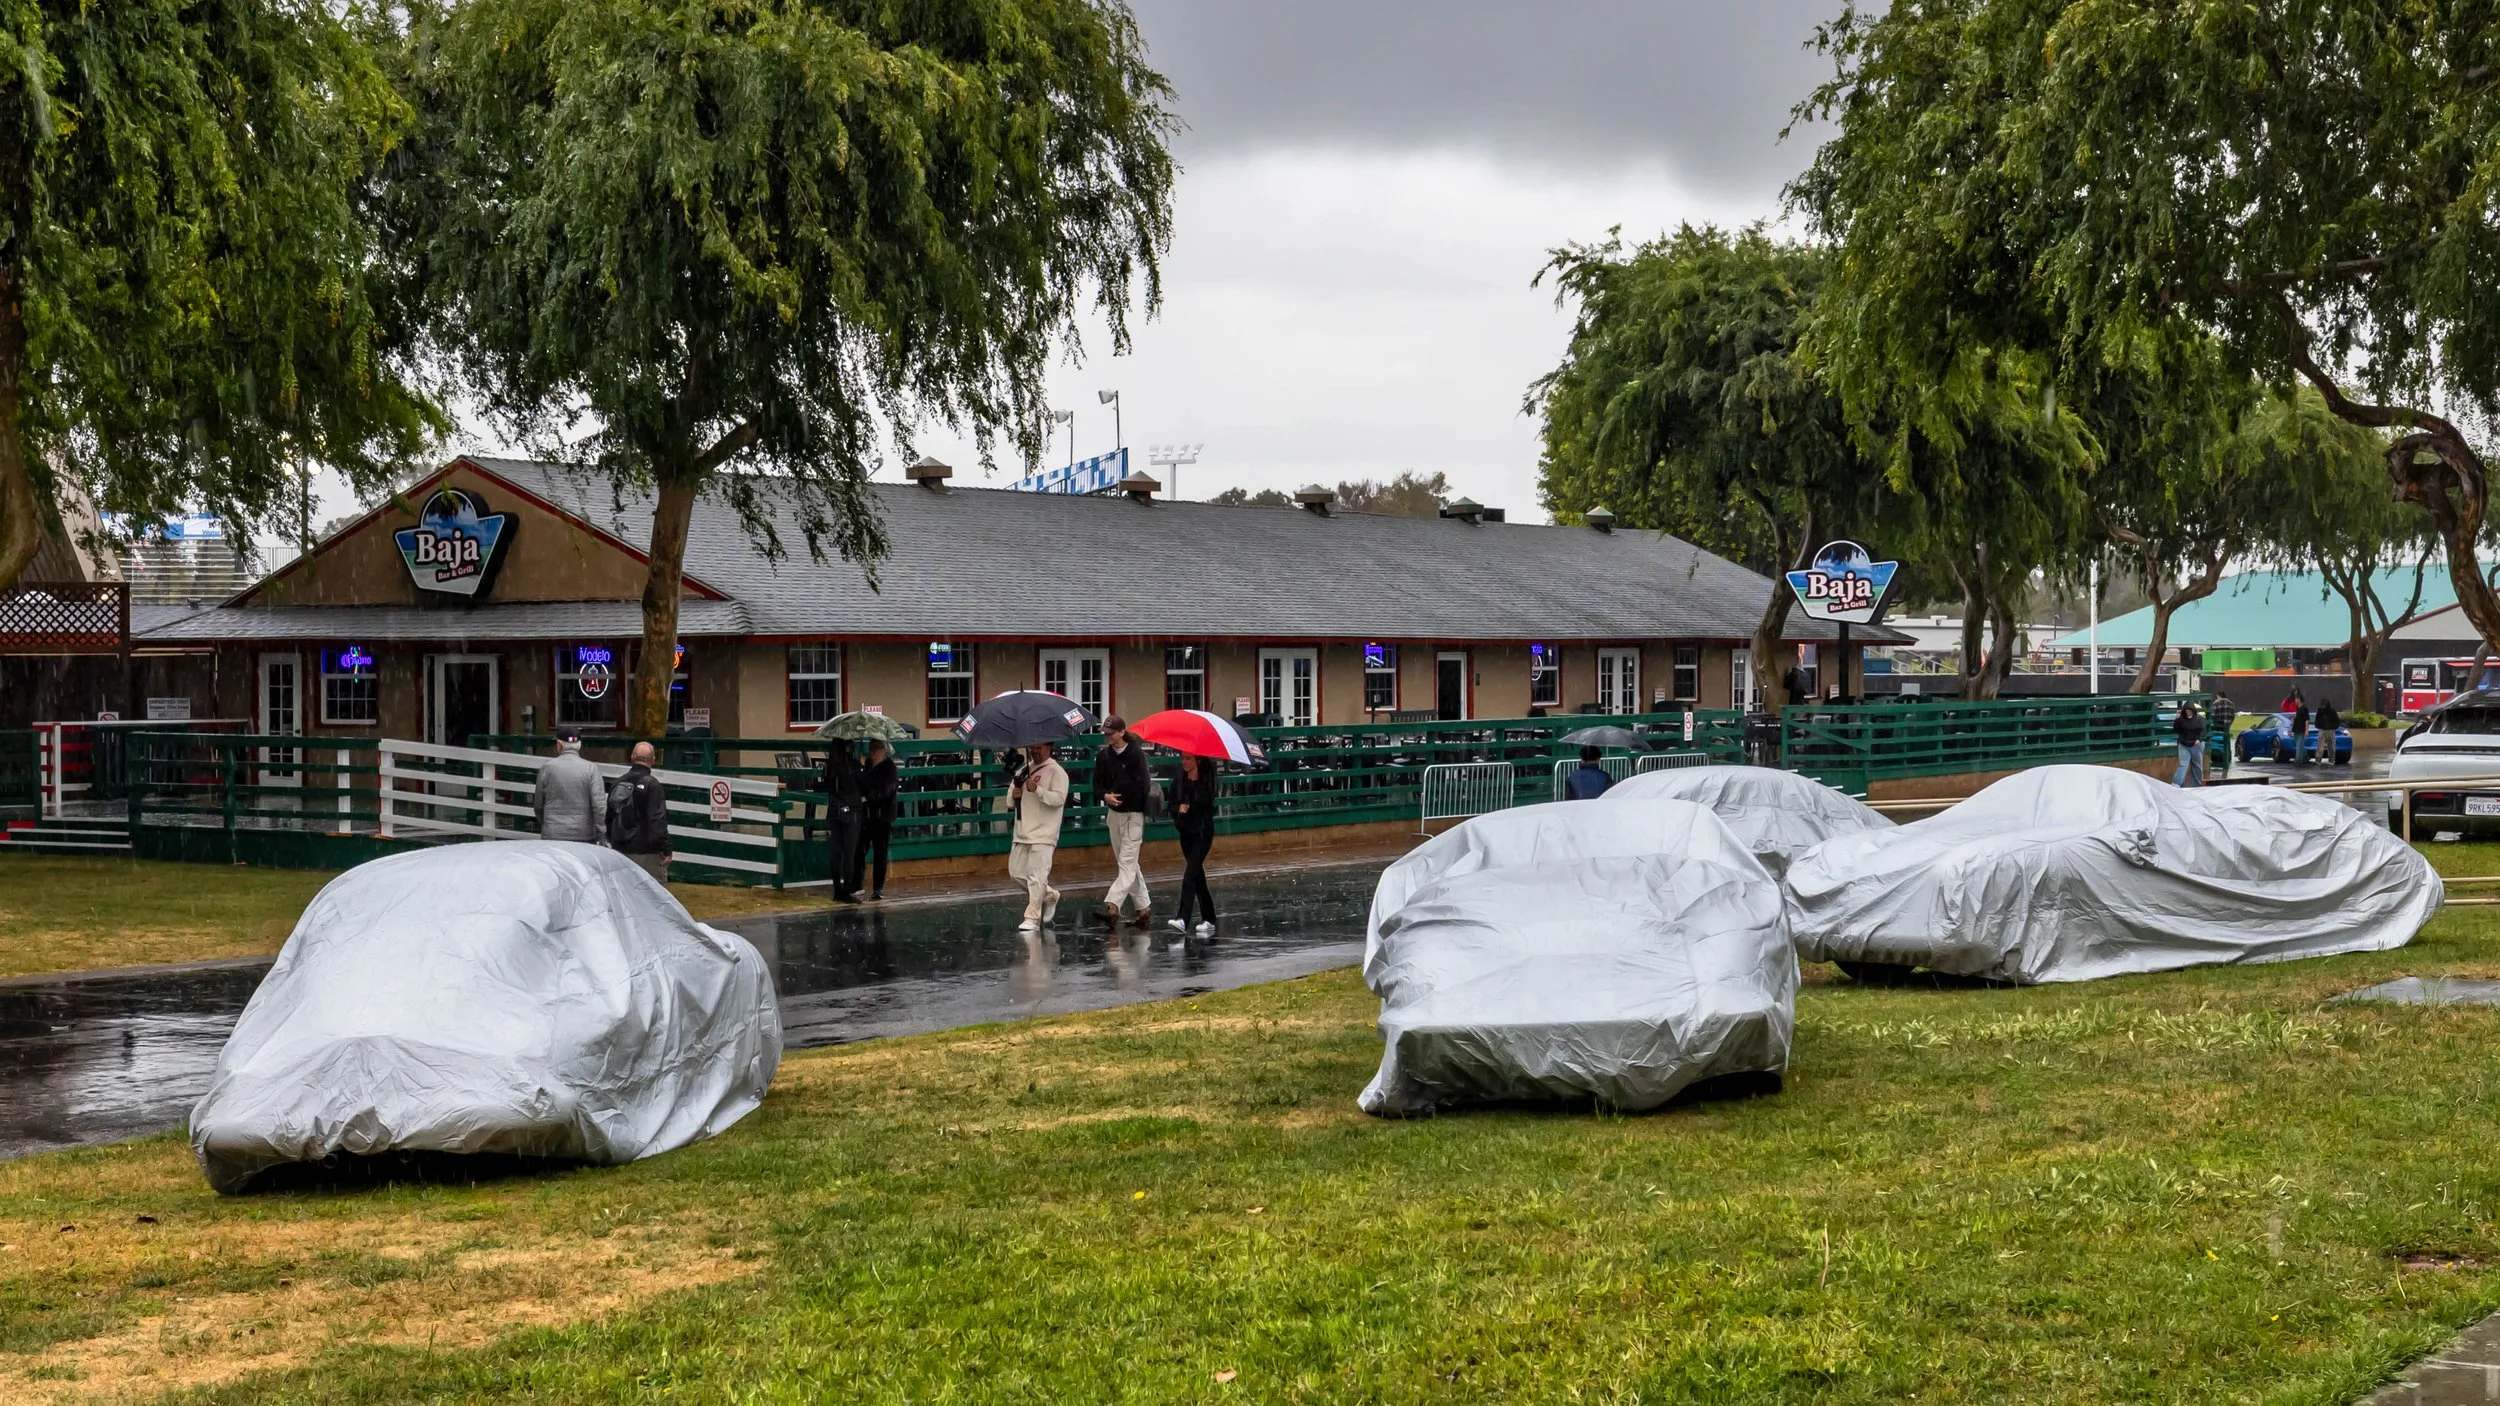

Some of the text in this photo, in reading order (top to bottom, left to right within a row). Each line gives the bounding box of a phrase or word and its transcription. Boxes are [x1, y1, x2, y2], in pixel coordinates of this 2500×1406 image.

[415, 530, 480, 569] Baja
[438, 572, 450, 580] Bar
[458, 565, 474, 575] Grill
[1807, 572, 1873, 603] Baja
[1829, 604, 1843, 612] Bar
[1850, 600, 1867, 608] Grill
[579, 646, 611, 662] Modelo
[2468, 803, 2500, 813] 9RKL595
